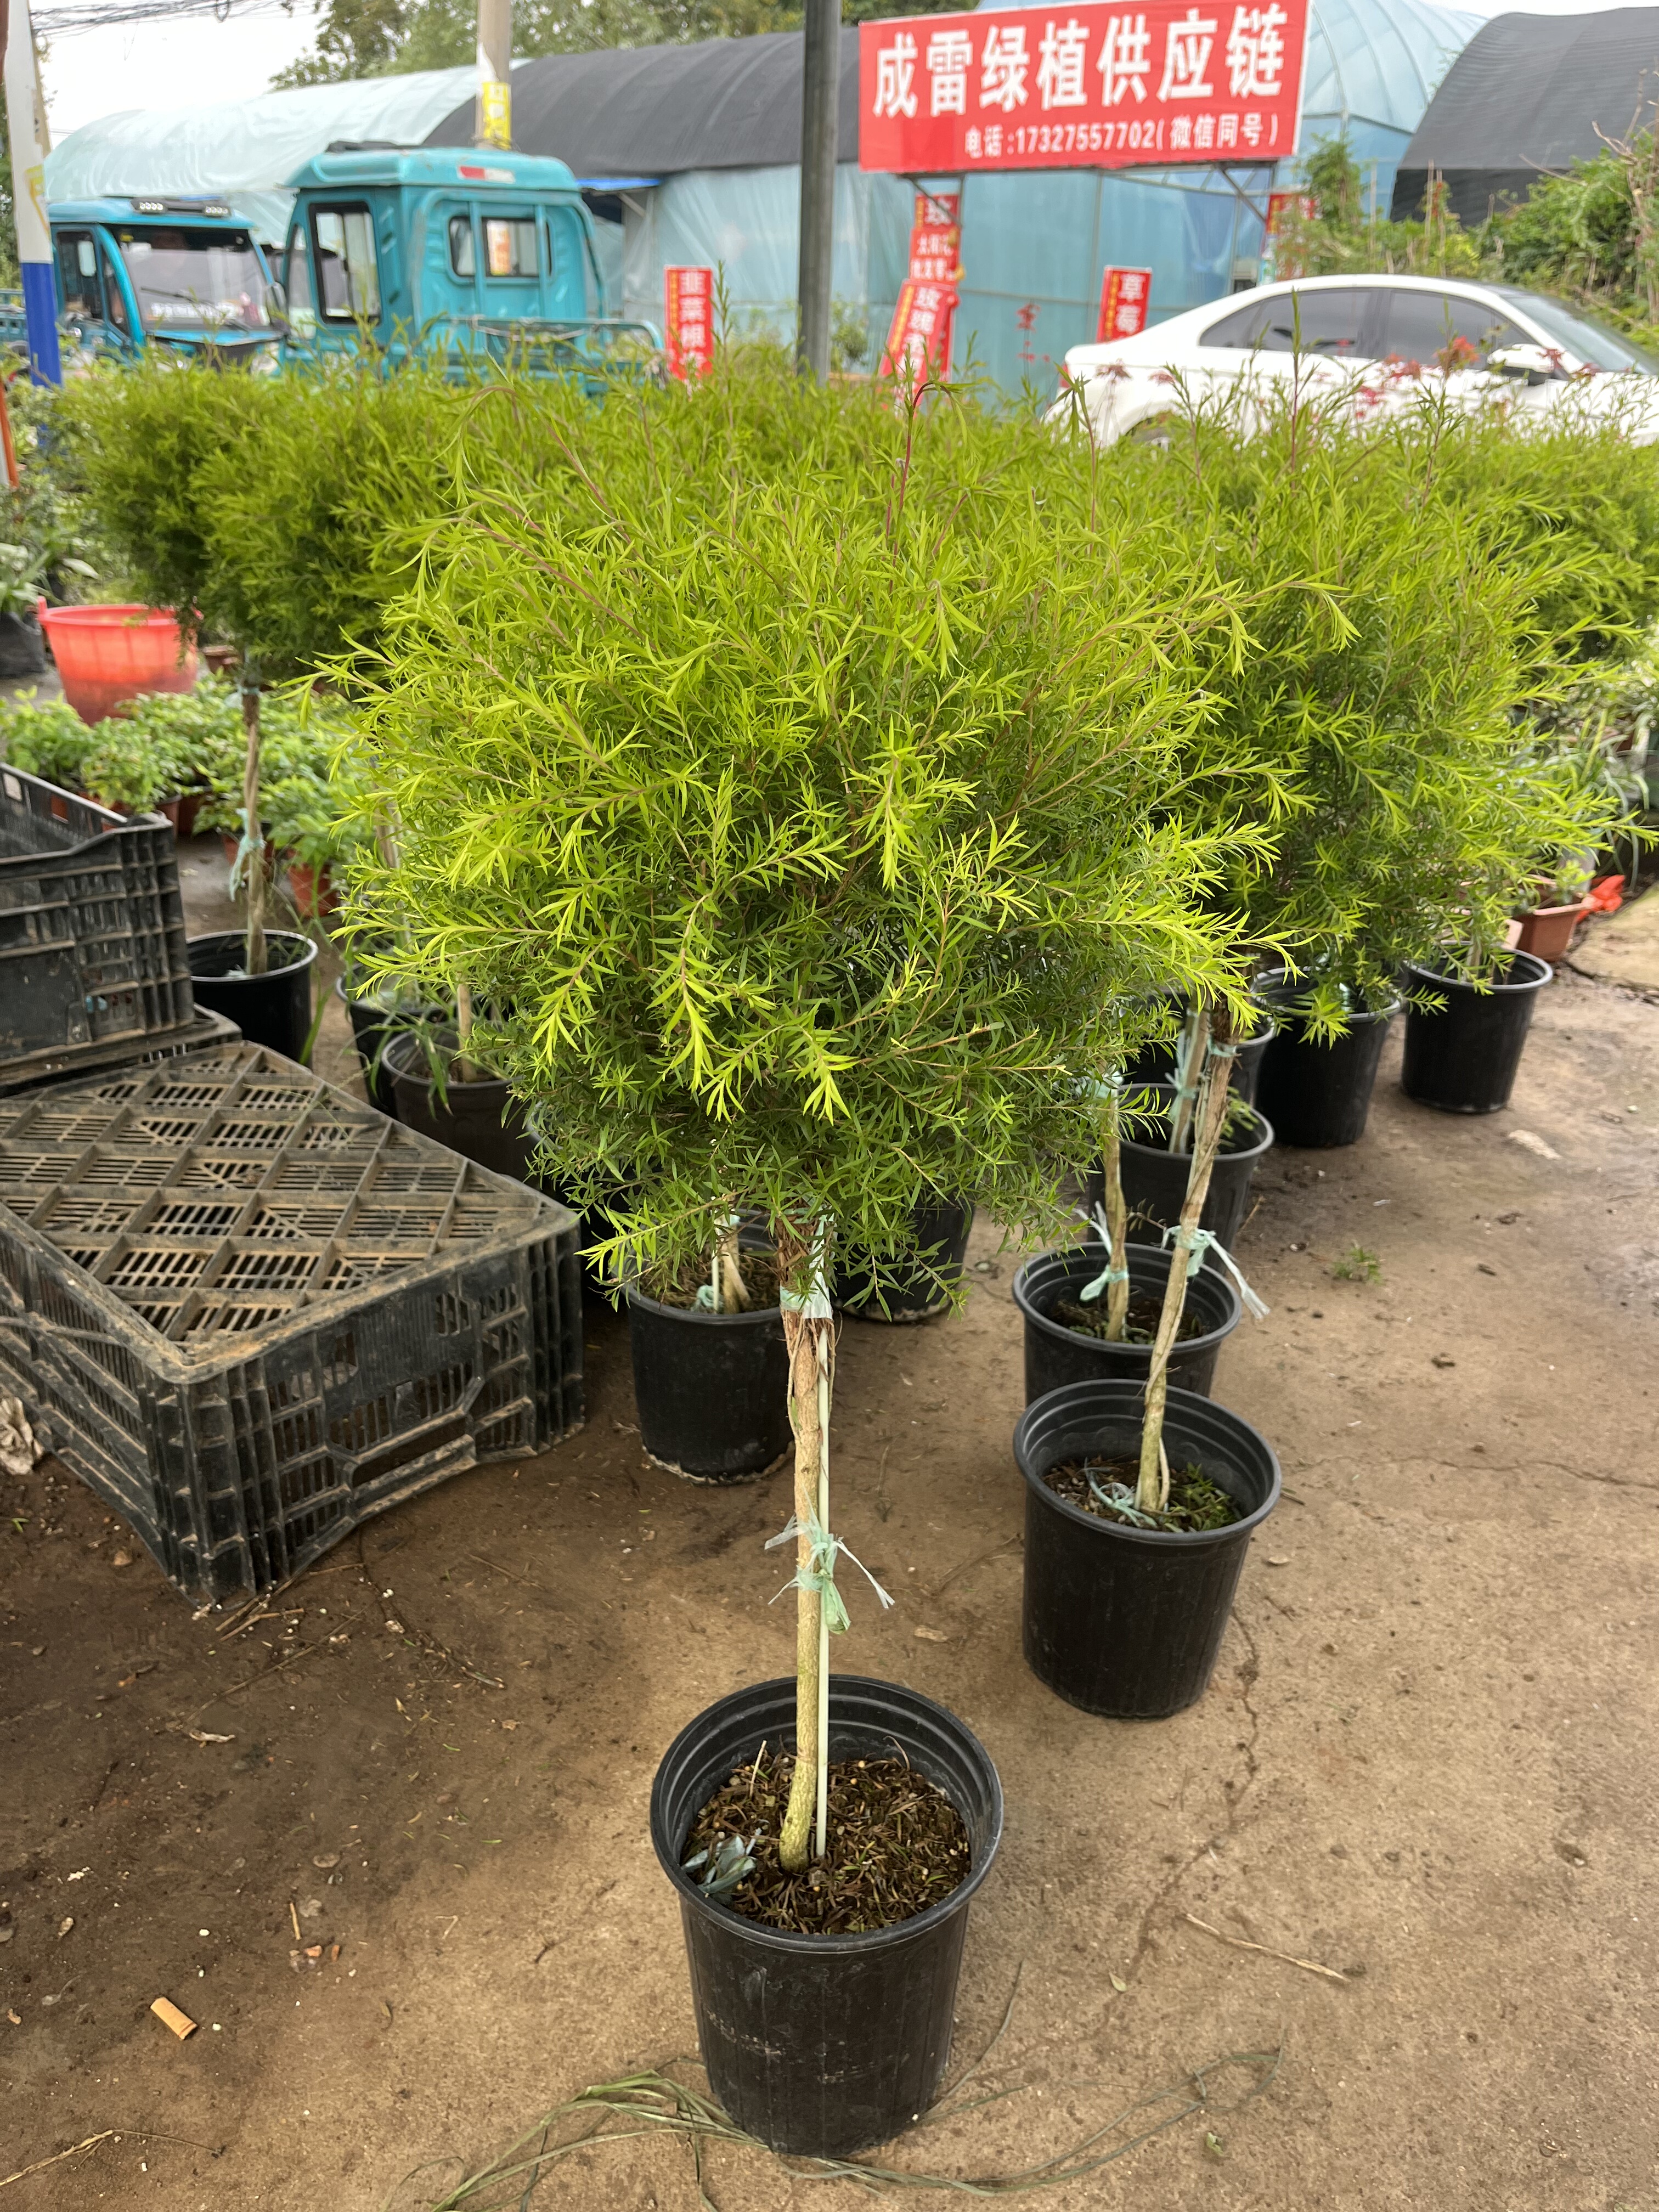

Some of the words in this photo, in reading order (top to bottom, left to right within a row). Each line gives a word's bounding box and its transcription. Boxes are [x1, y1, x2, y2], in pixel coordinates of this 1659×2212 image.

[872, 3, 1288, 118] 成雷绿植供应链
